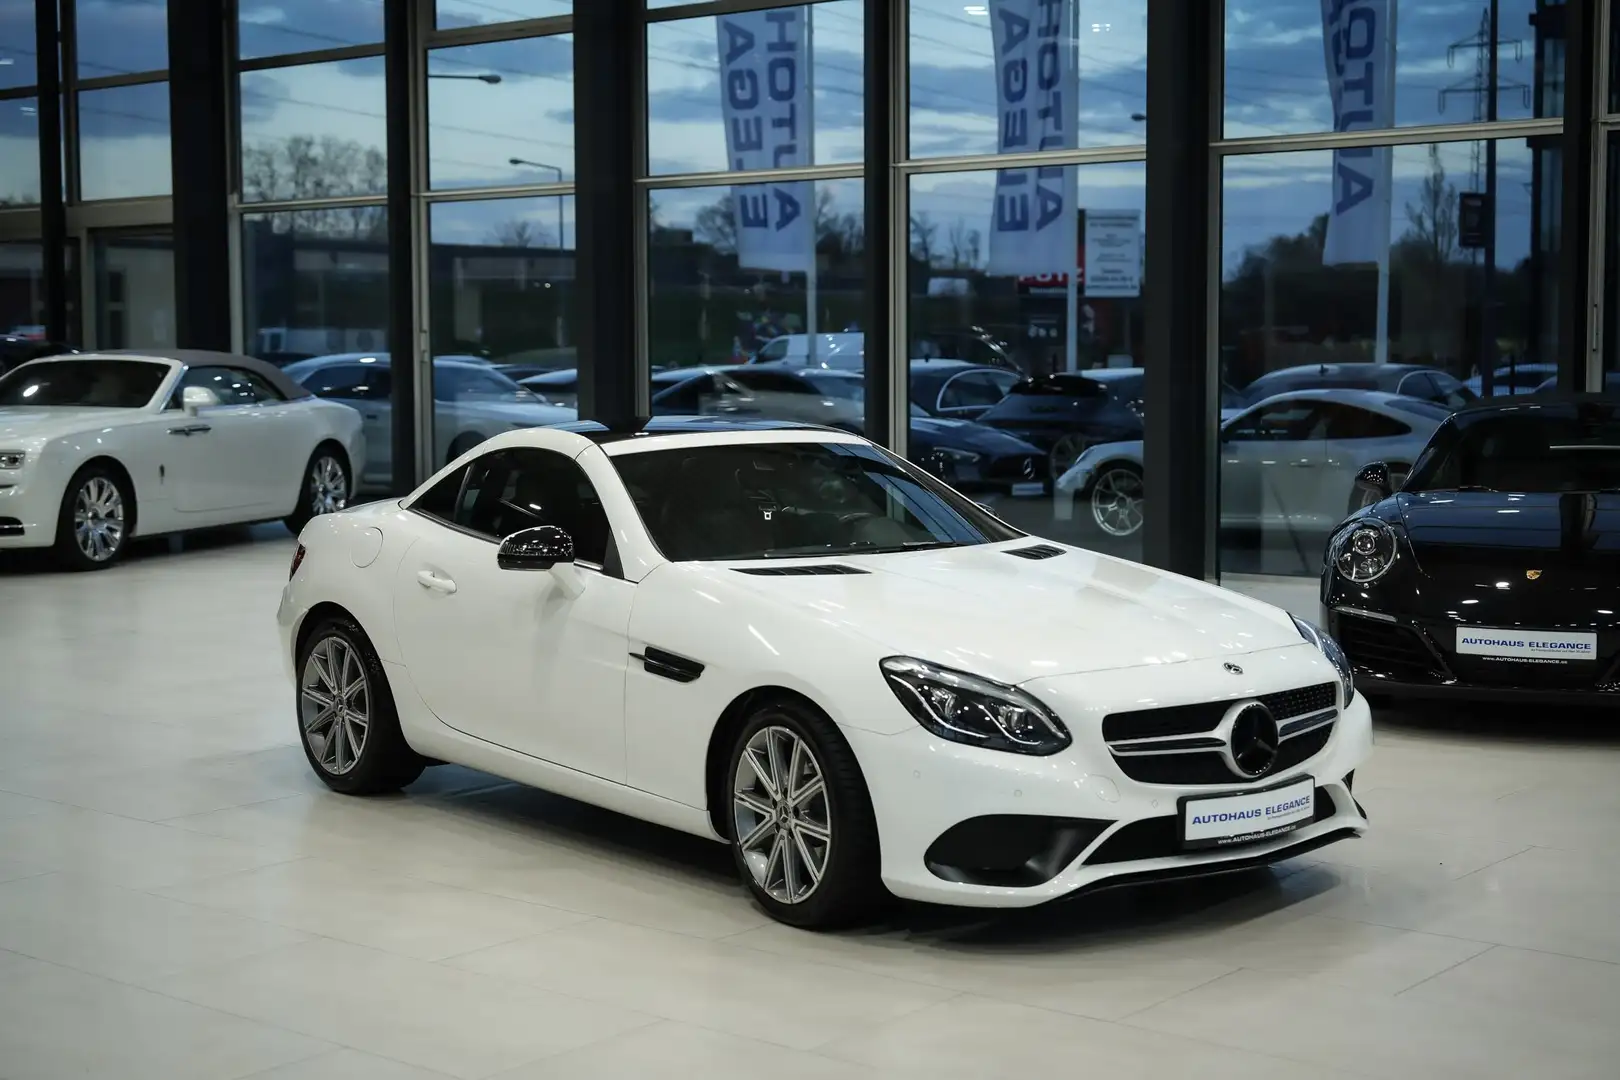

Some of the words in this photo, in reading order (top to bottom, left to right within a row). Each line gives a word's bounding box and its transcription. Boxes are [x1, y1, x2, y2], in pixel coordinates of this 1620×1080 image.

[1461, 637, 1525, 648] AUTOHAUS
[1528, 641, 1592, 650] ELEGANCE
[1191, 808, 1262, 825] AUTOHAUS
[1265, 795, 1311, 816] ELEGANCE
